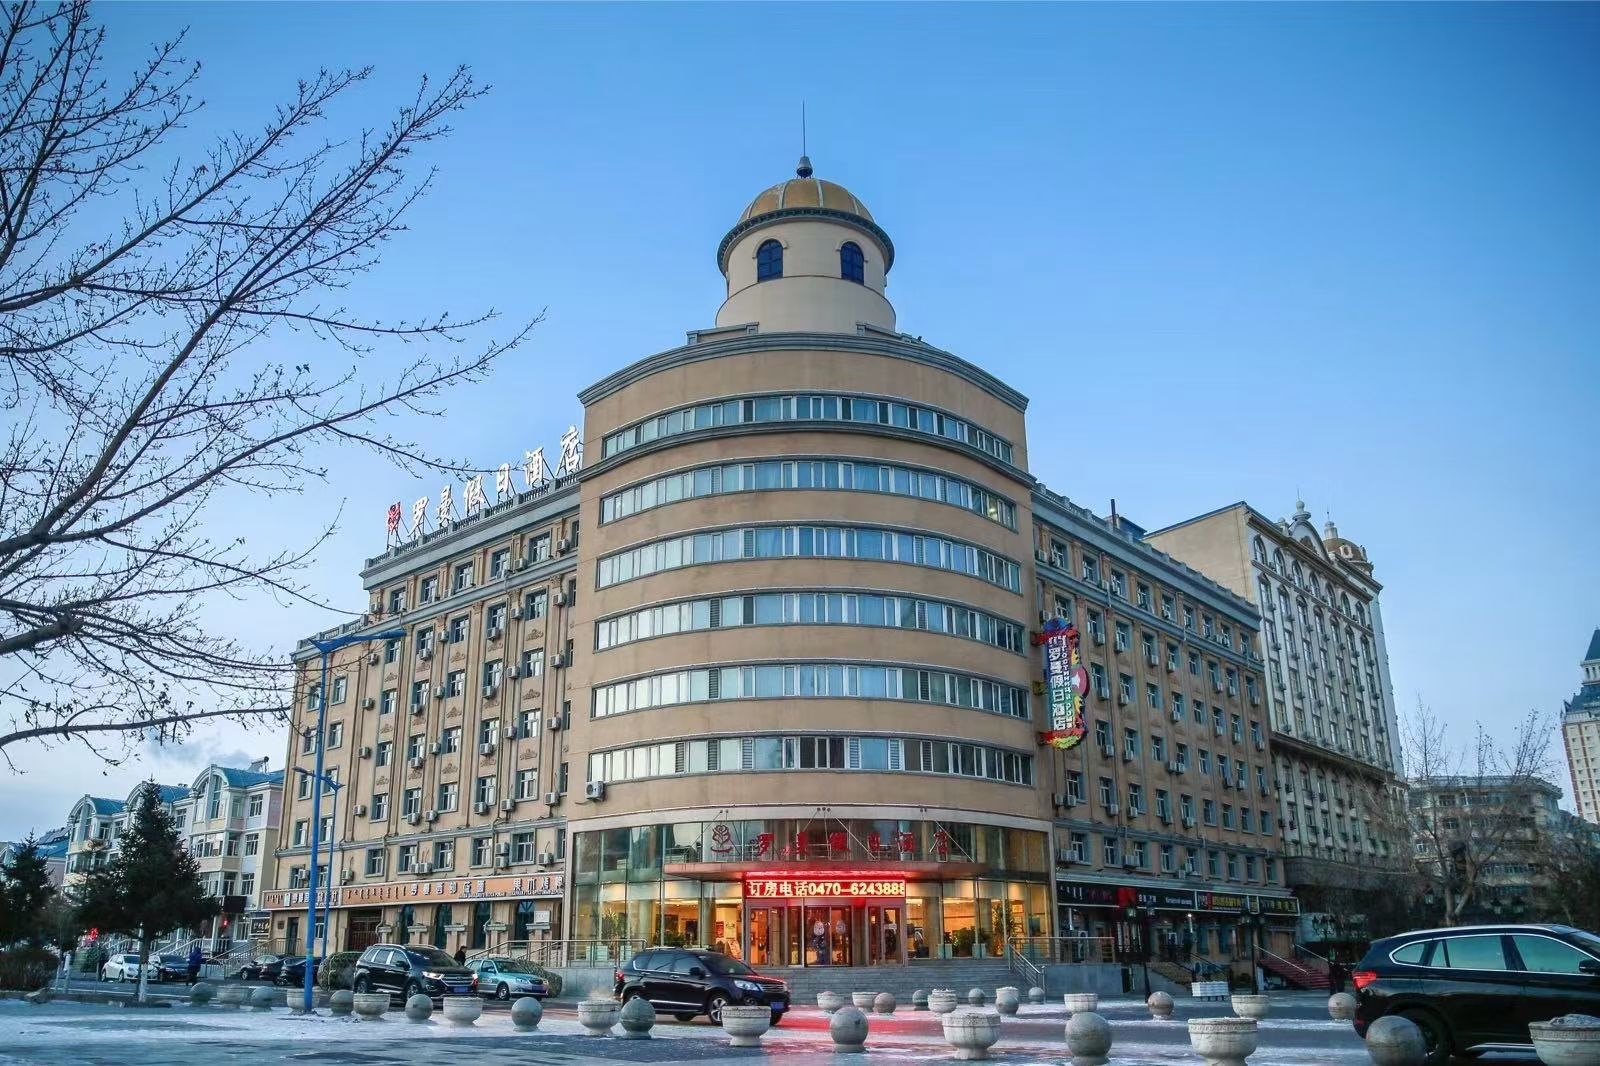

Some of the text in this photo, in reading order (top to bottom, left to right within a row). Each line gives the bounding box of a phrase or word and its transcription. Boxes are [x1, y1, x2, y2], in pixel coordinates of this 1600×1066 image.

[408, 425, 581, 537] 罗曼假日酒店
[1049, 647, 1066, 730] 罗曼假日酒店
